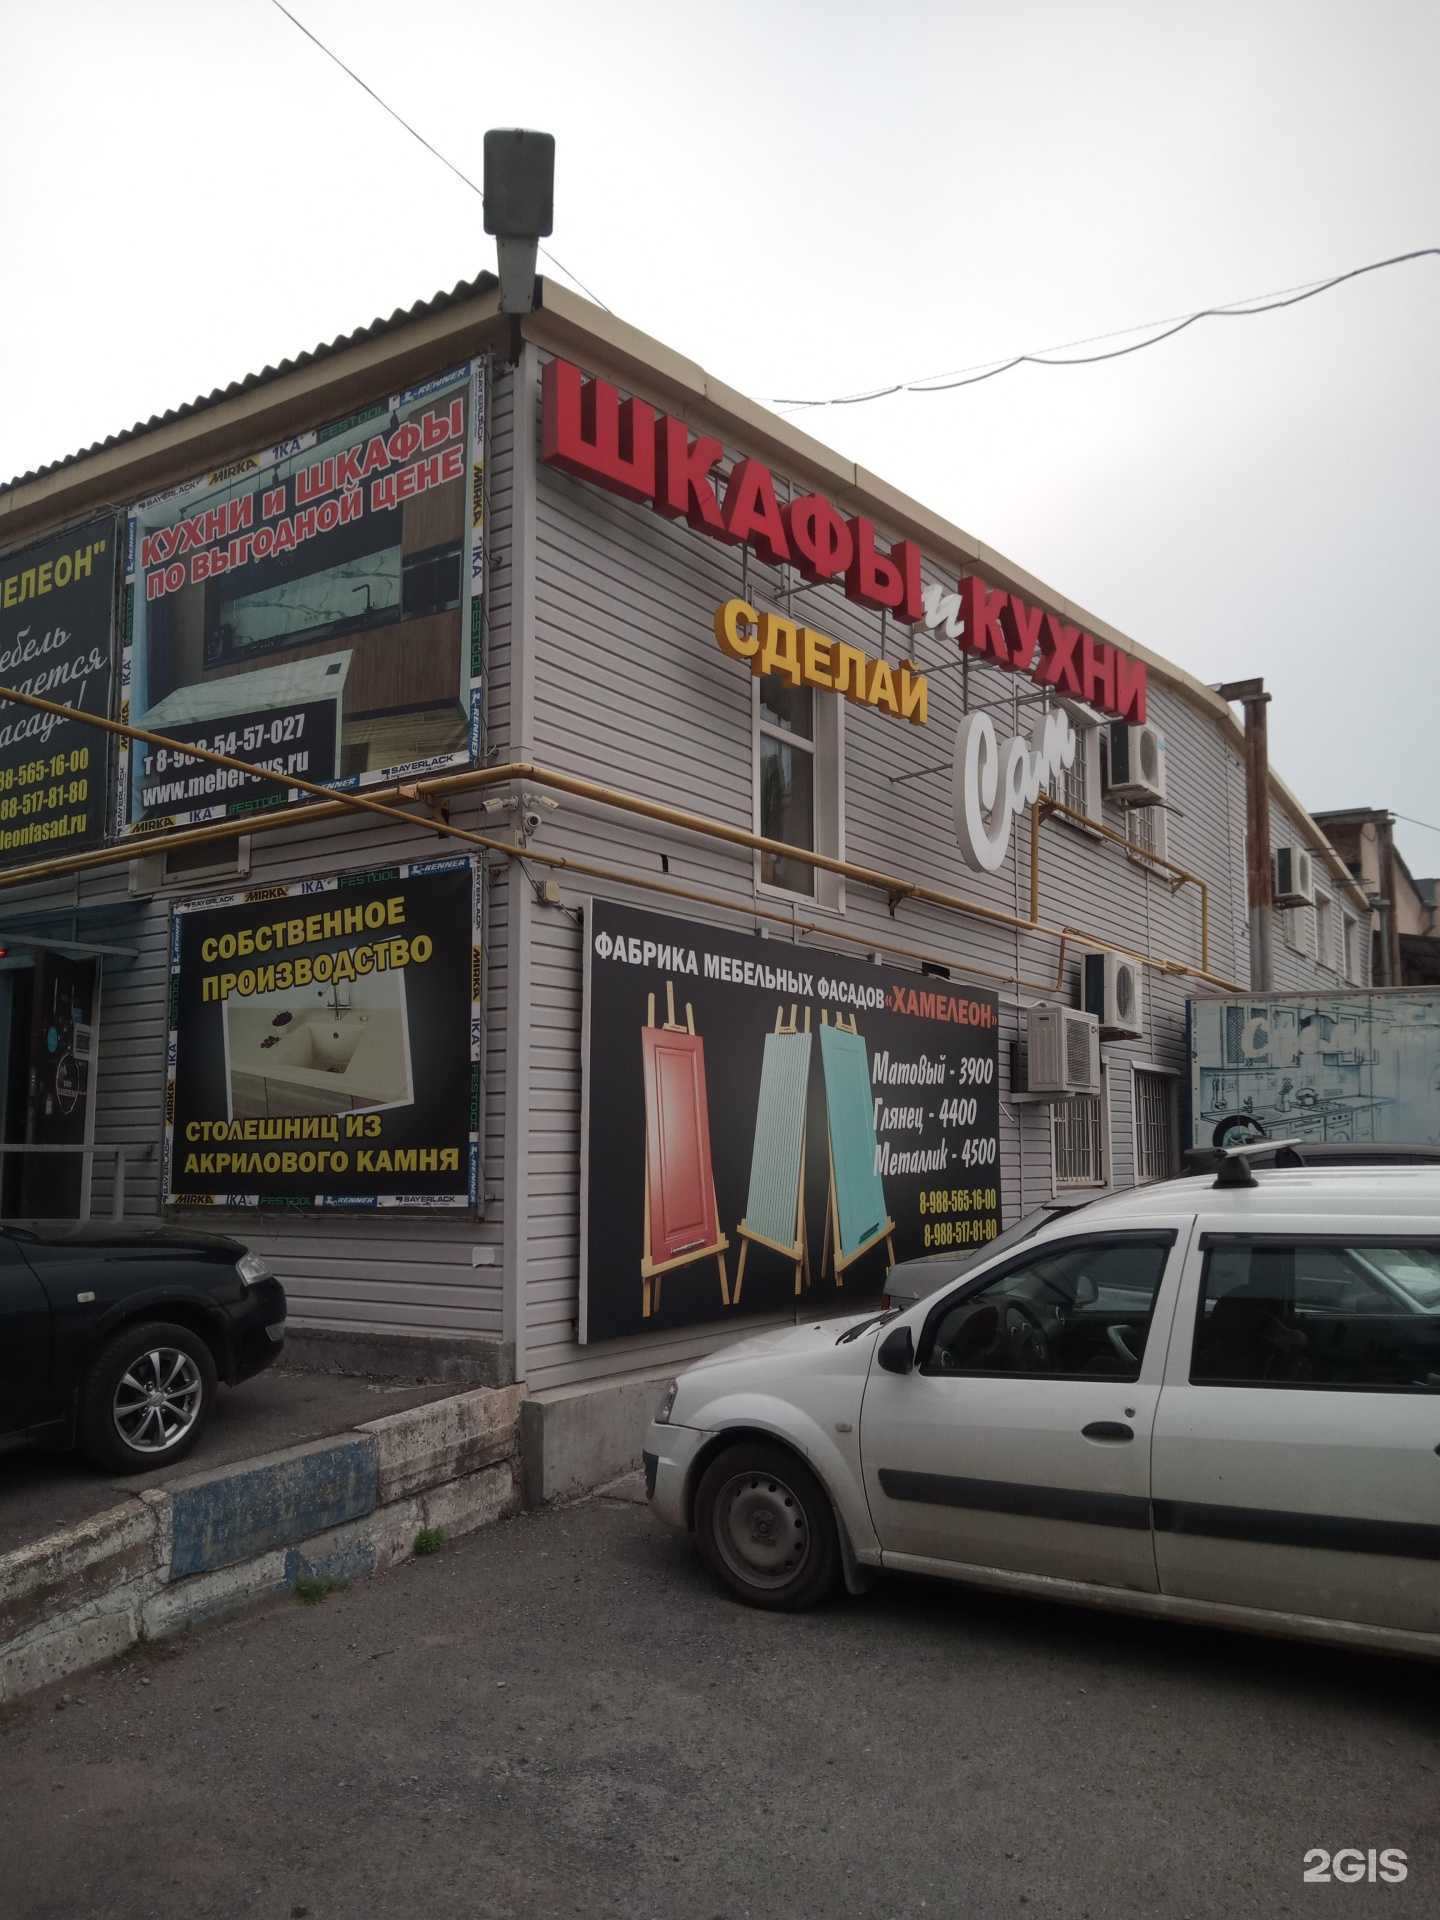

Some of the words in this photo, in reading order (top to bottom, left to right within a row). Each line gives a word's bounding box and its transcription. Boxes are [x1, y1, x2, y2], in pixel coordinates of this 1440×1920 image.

[140, 492, 253, 569] КУХНИ
[263, 485, 285, 520] и
[295, 397, 464, 506] ШКАФЫ
[208, 458, 258, 486] MIRKA
[472, 465, 483, 527] MIRKA
[147, 562, 185, 601] ПО
[191, 481, 363, 584] ВЫГОДНОЙ
[371, 443, 464, 512] ЦЕНЕ
[542, 358, 922, 624] ШКАФЫ
[922, 584, 964, 640] и
[959, 576, 1147, 725] КУХНИ
[0, 540, 106, 608] ЕЛЕОН"
[472, 546, 482, 578] IKA
[714, 597, 928, 725] СДЕЛАЙ
[131, 816, 175, 834] MIRKA
[189, 808, 213, 823] IKA
[391, 754, 454, 774] SAYERLACK
[952, 708, 1076, 873] Сам
[245, 887, 287, 902] MIRKA
[302, 881, 324, 894] IKA
[340, 870, 397, 889] FESTOOL
[202, 896, 406, 962] СОБСТВЕННОЕ
[202, 935, 433, 1002] ПРОИЗВОДСТВО
[473, 949, 481, 1000] MIRKA
[595, 931, 699, 976] ФАБРИКА
[704, 953, 814, 997] МЕБЕЛЬНЫХ
[817, 977, 885, 1010] ФАСАДОВ
[885, 985, 998, 1029] «ХАМЕЛЕОН»
[472, 1018, 480, 1045] IKA
[168, 1043, 177, 1066] IKA
[872, 1051, 945, 1086] Матовый
[959, 1057, 993, 1086] 3900
[185, 1115, 339, 1142] СТОЛЕШНИЦ
[346, 1114, 382, 1138] ИЗ
[873, 1097, 924, 1134] Глянец
[939, 1098, 977, 1127] 4400
[184, 1150, 349, 1174] АКРИЛОВОГО
[356, 1148, 459, 1173] КАМНЯ
[873, 1138, 949, 1176] Металлик
[962, 1138, 996, 1168] 4500
[227, 1194, 246, 1205] IKA
[919, 1188, 997, 1216] 8-988-565-16-00
[924, 1219, 997, 1248] 8-988-517-81-80
